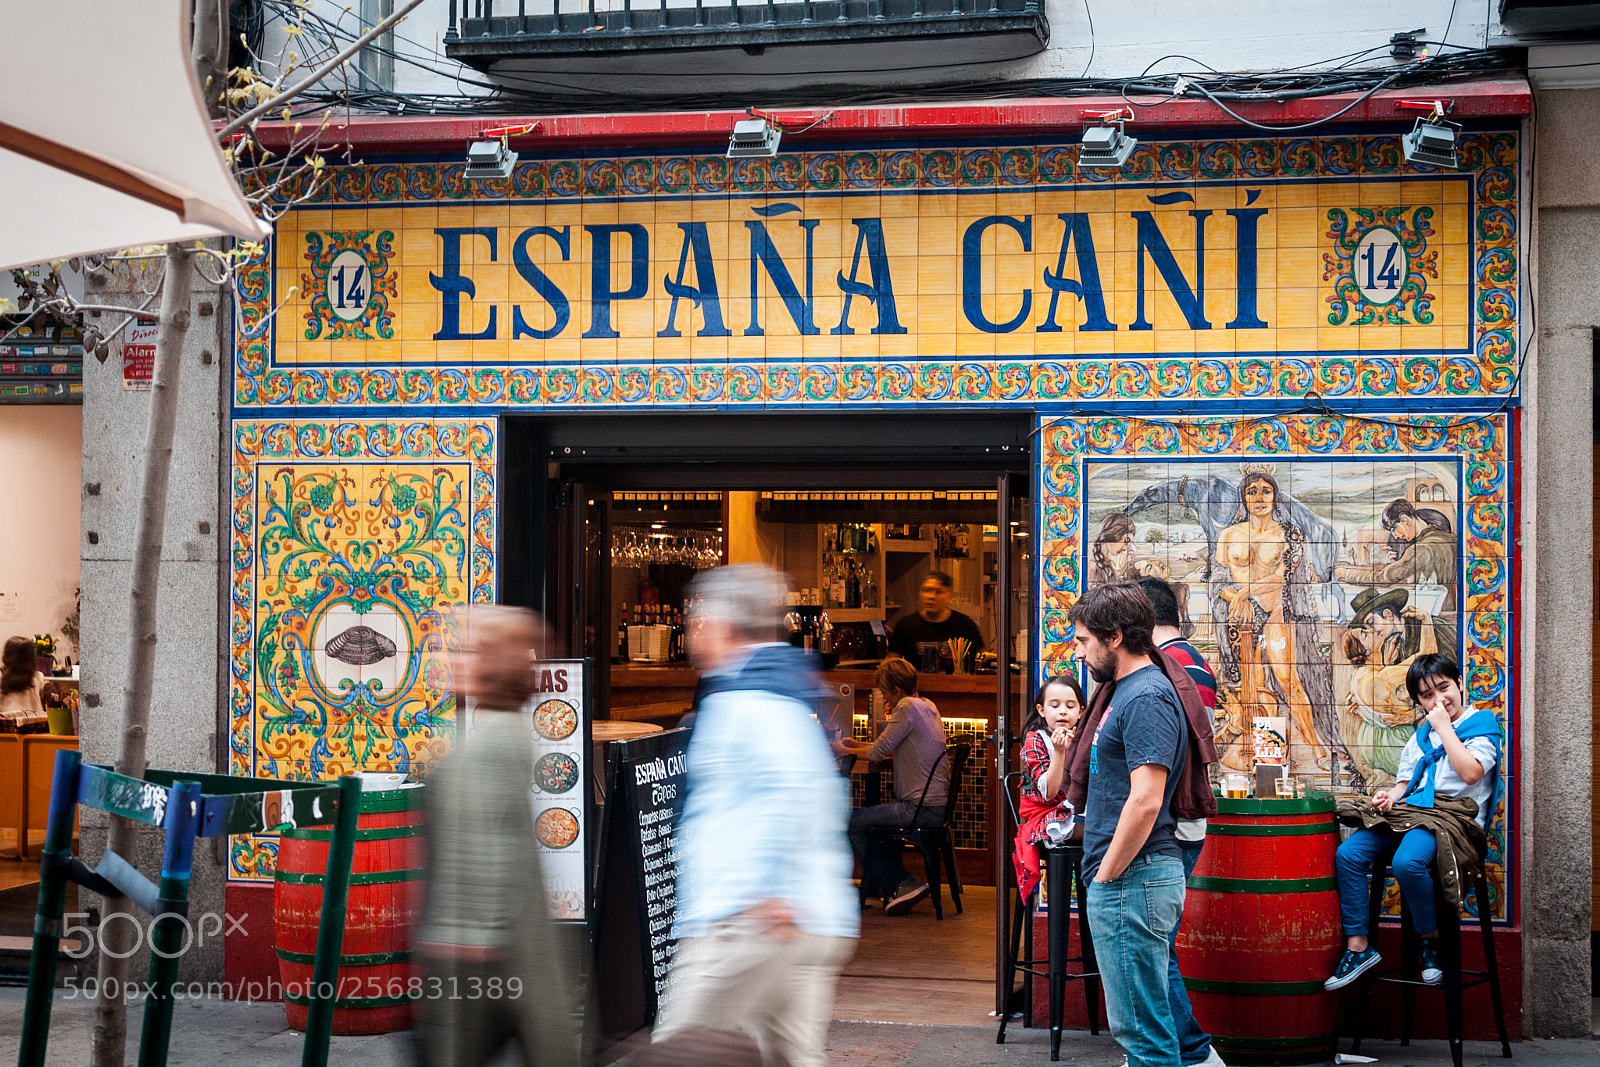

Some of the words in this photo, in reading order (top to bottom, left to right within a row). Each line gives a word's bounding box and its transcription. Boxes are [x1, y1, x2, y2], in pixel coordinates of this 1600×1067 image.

[429, 202, 908, 340] ESPAÑA
[962, 189, 1269, 334] CAÑÍ
[1361, 242, 1400, 290] 14
[332, 265, 365, 309] 14
[126, 347, 156, 357] Alarm
[529, 668, 568, 693] LAS
[635, 756, 668, 786] ESPAÑA
[651, 783, 677, 806] Tapas
